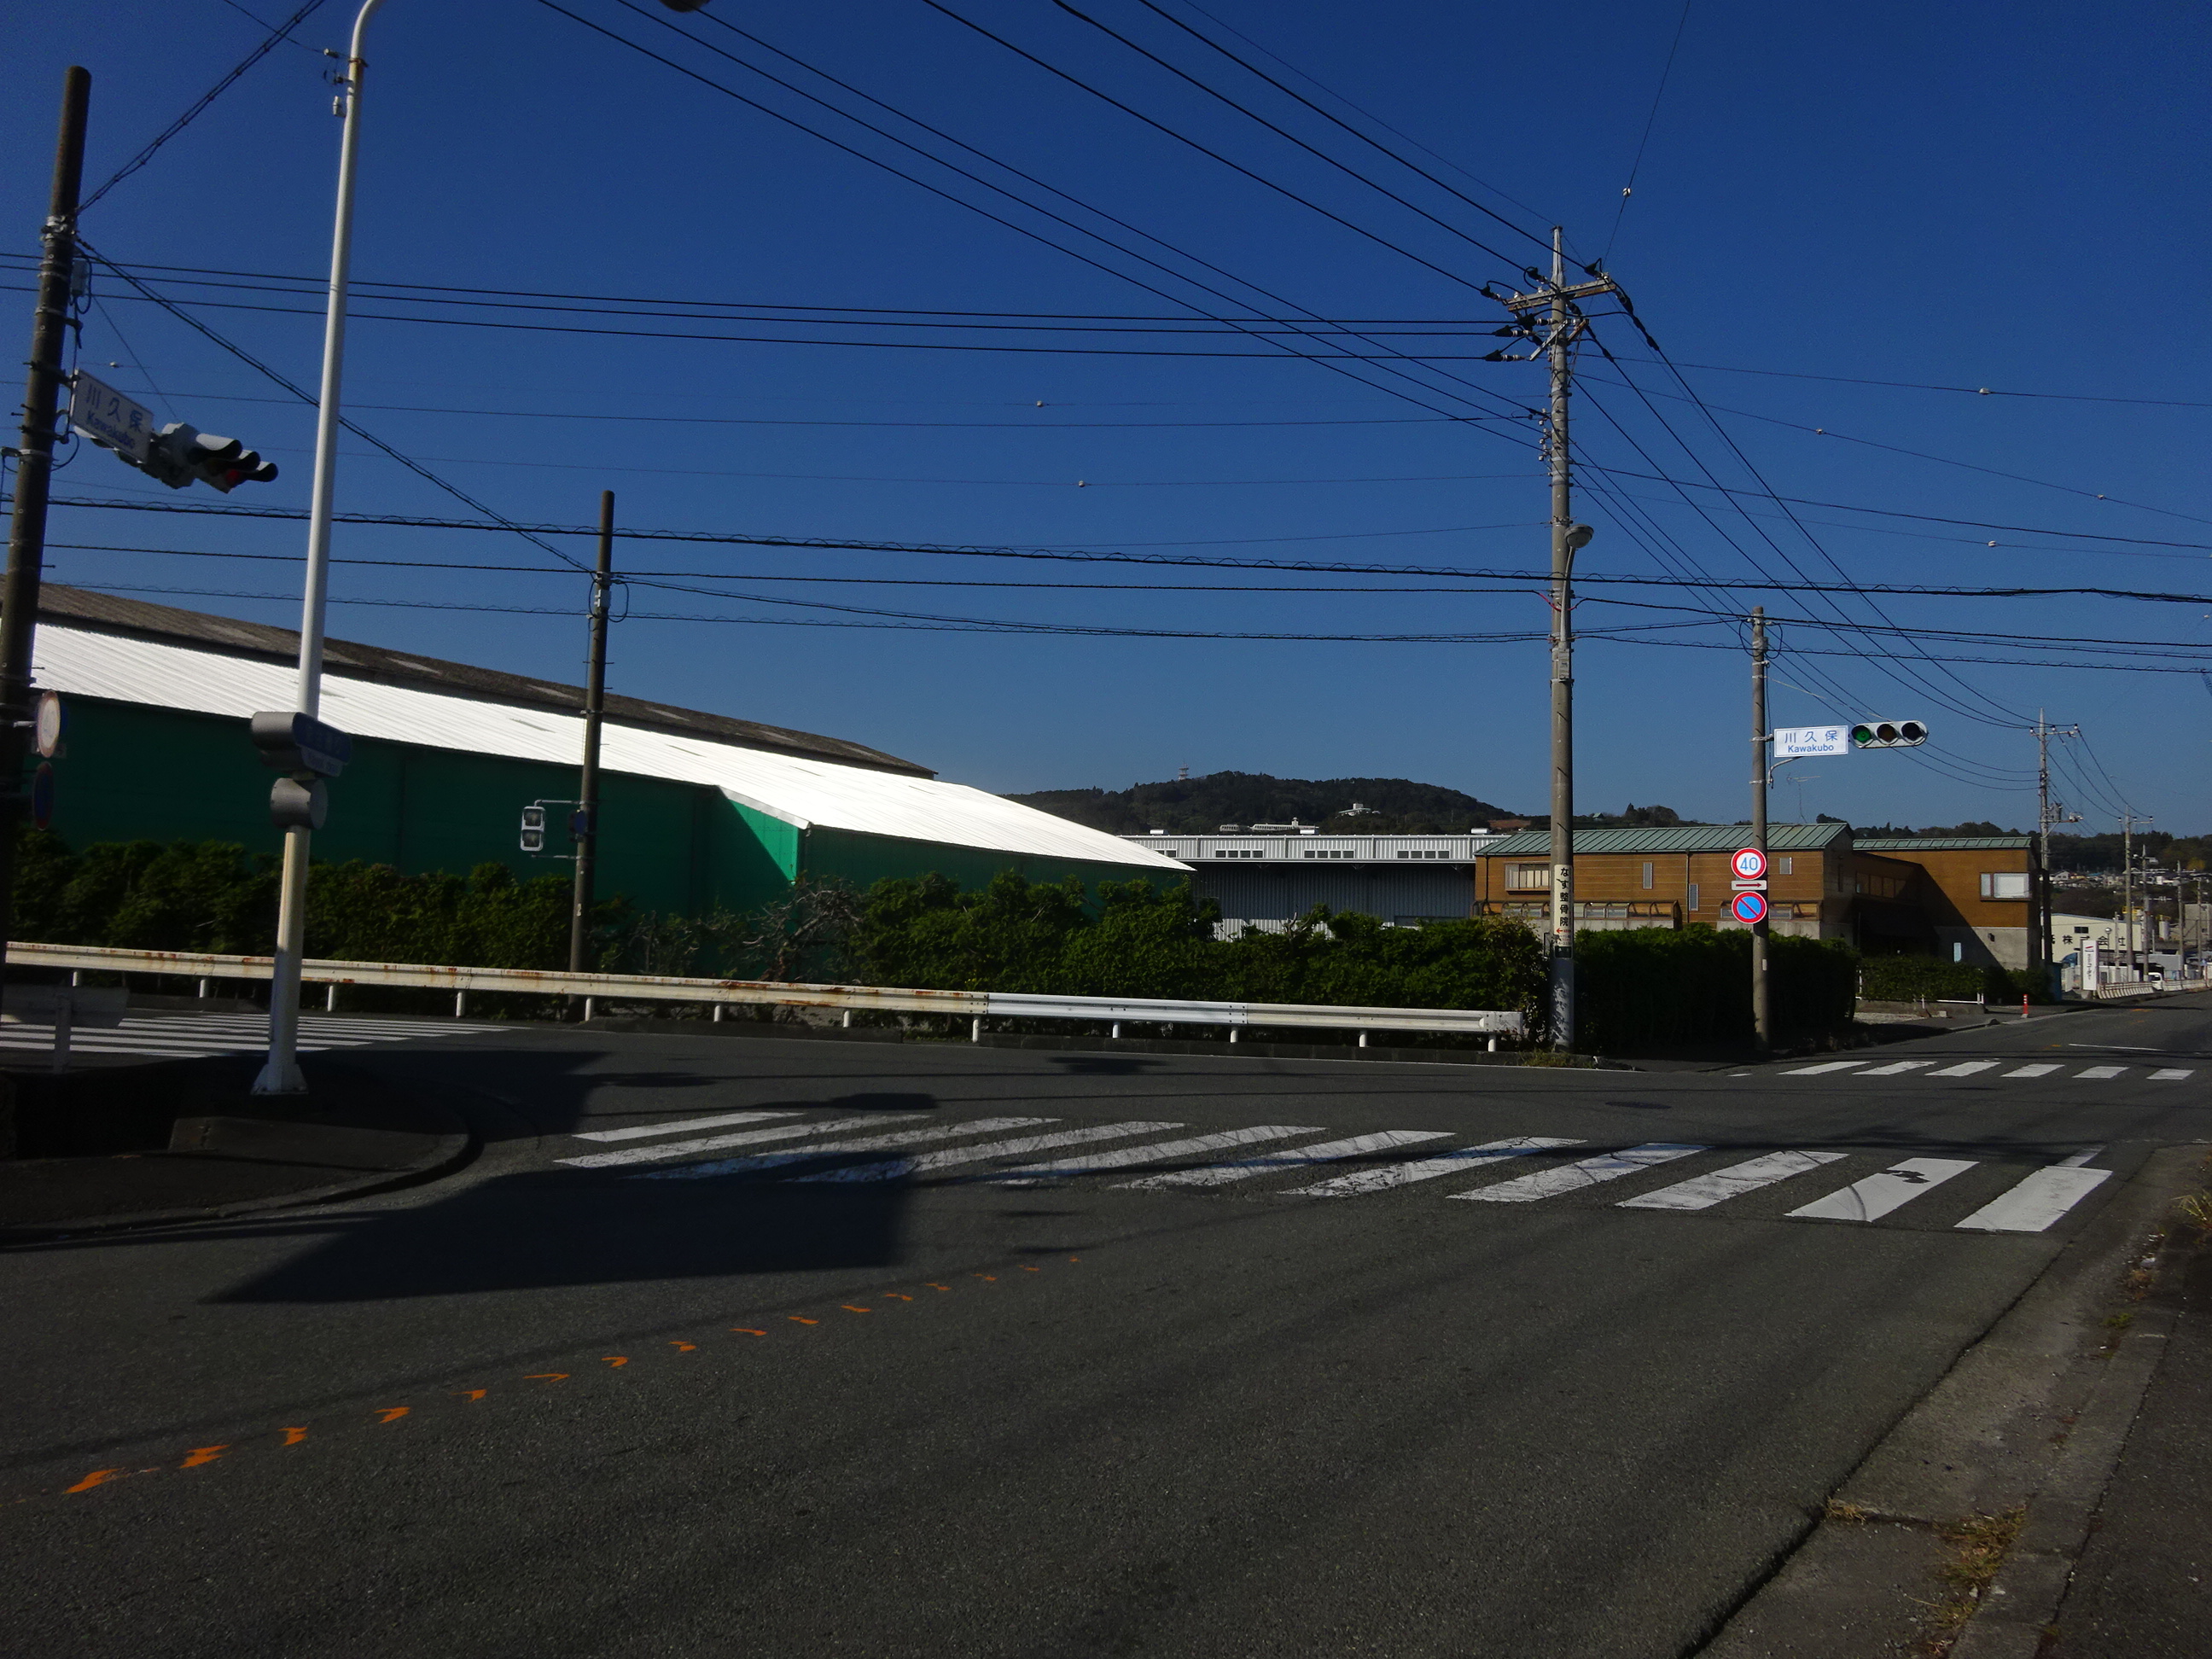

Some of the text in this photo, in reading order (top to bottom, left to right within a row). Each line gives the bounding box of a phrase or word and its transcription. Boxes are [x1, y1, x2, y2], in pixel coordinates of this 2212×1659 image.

[85, 383, 143, 434] 川久保
[86, 410, 136, 450] Kawakubo
[1784, 730, 1839, 744] 川久保
[1787, 743, 1835, 754] Kawakubo
[1740, 857, 1758, 871] 40
[1558, 867, 1569, 928] なす整骨院
